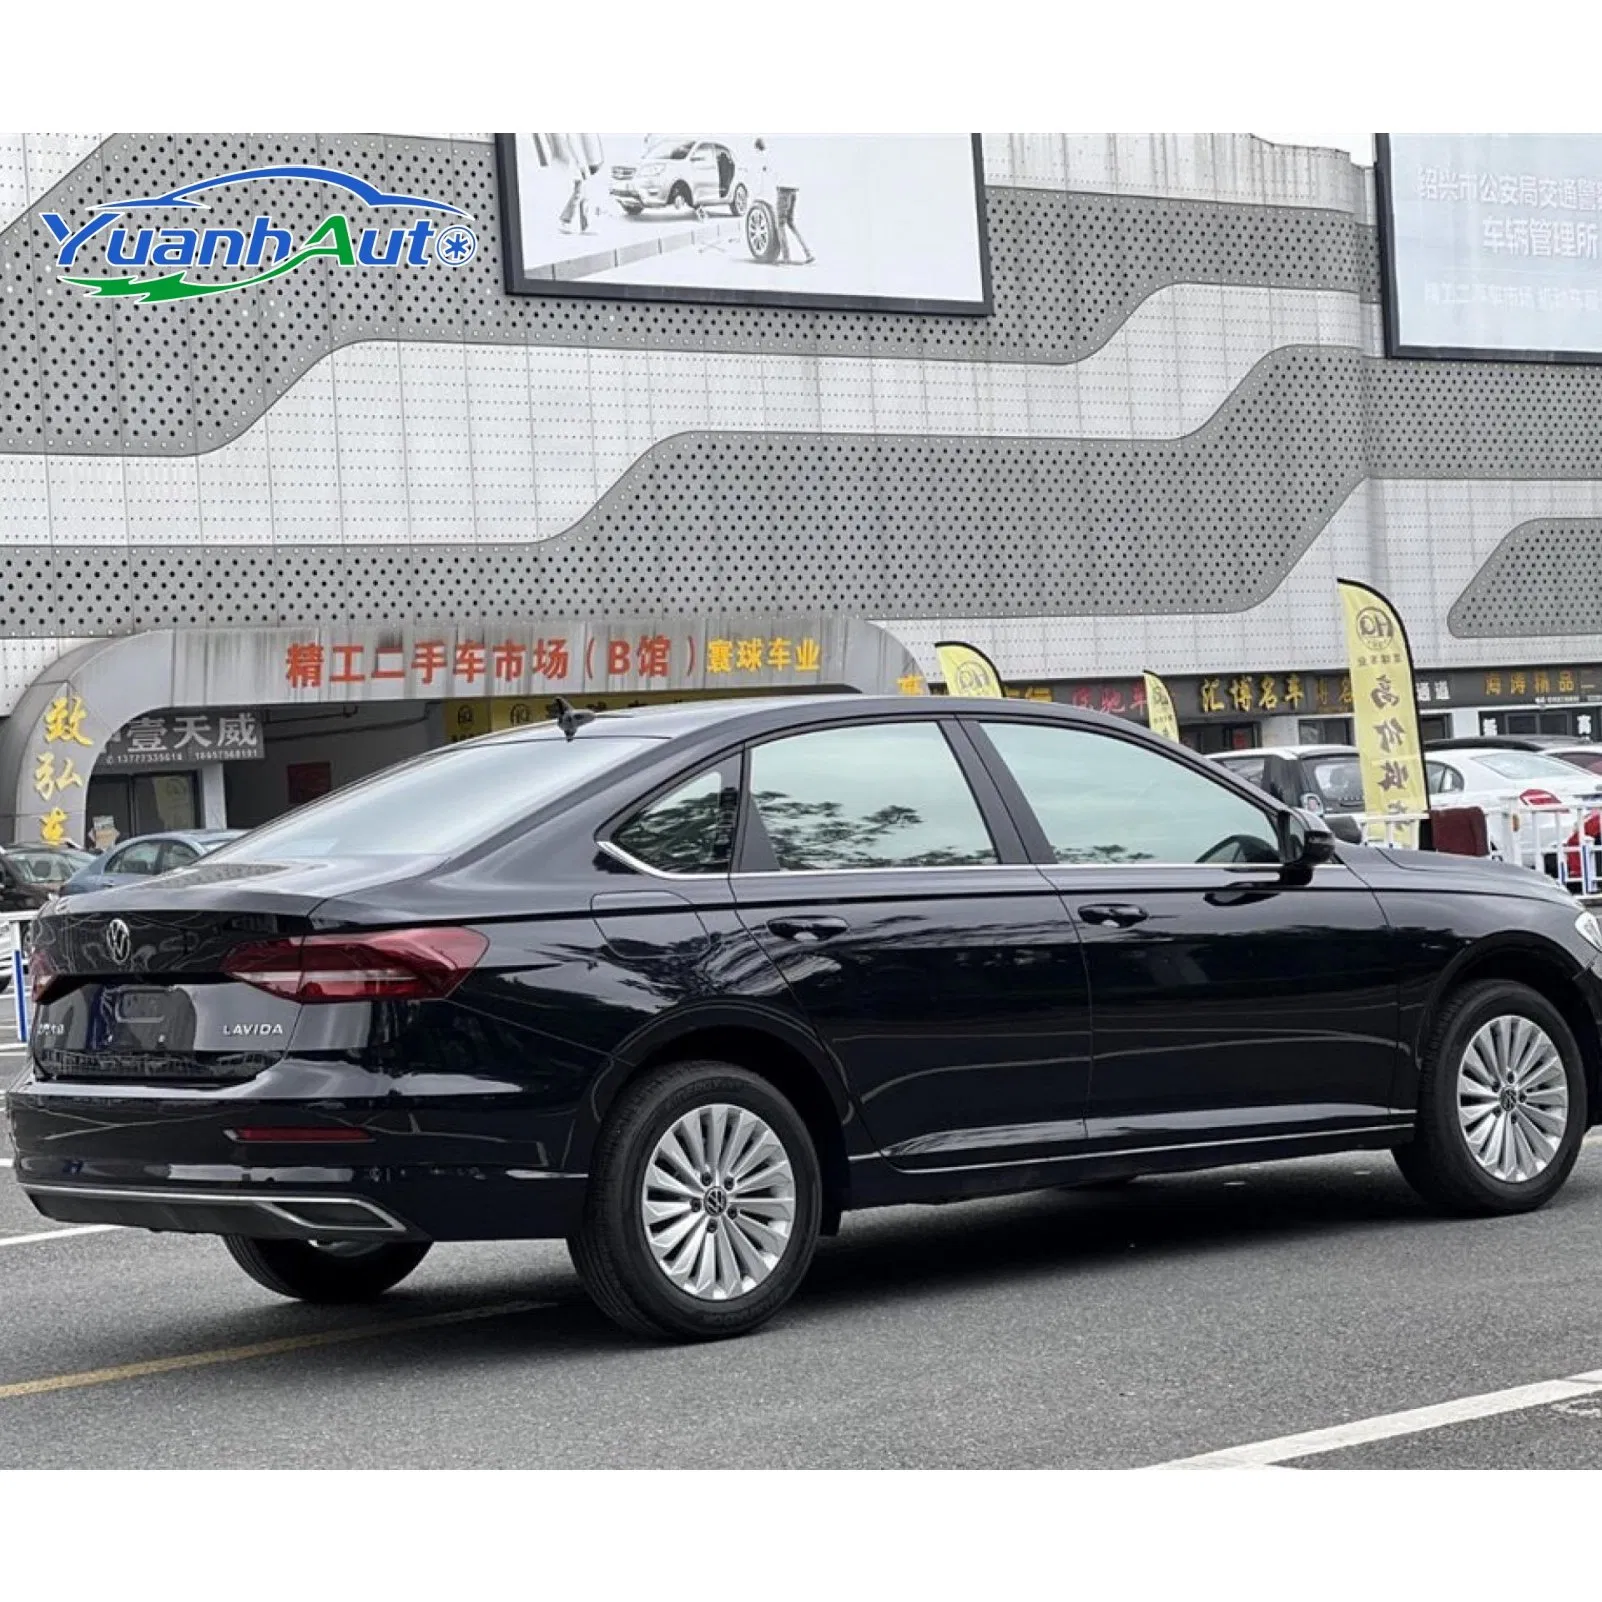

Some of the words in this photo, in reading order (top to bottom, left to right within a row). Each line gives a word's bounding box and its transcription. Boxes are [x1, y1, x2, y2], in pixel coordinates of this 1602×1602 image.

[1418, 167, 1602, 212] 绍兴市公安局交通警
[1483, 216, 1599, 260] 车辆管理所
[111, 713, 257, 752] 壹天威
[222, 1024, 283, 1036] LAVIDA
